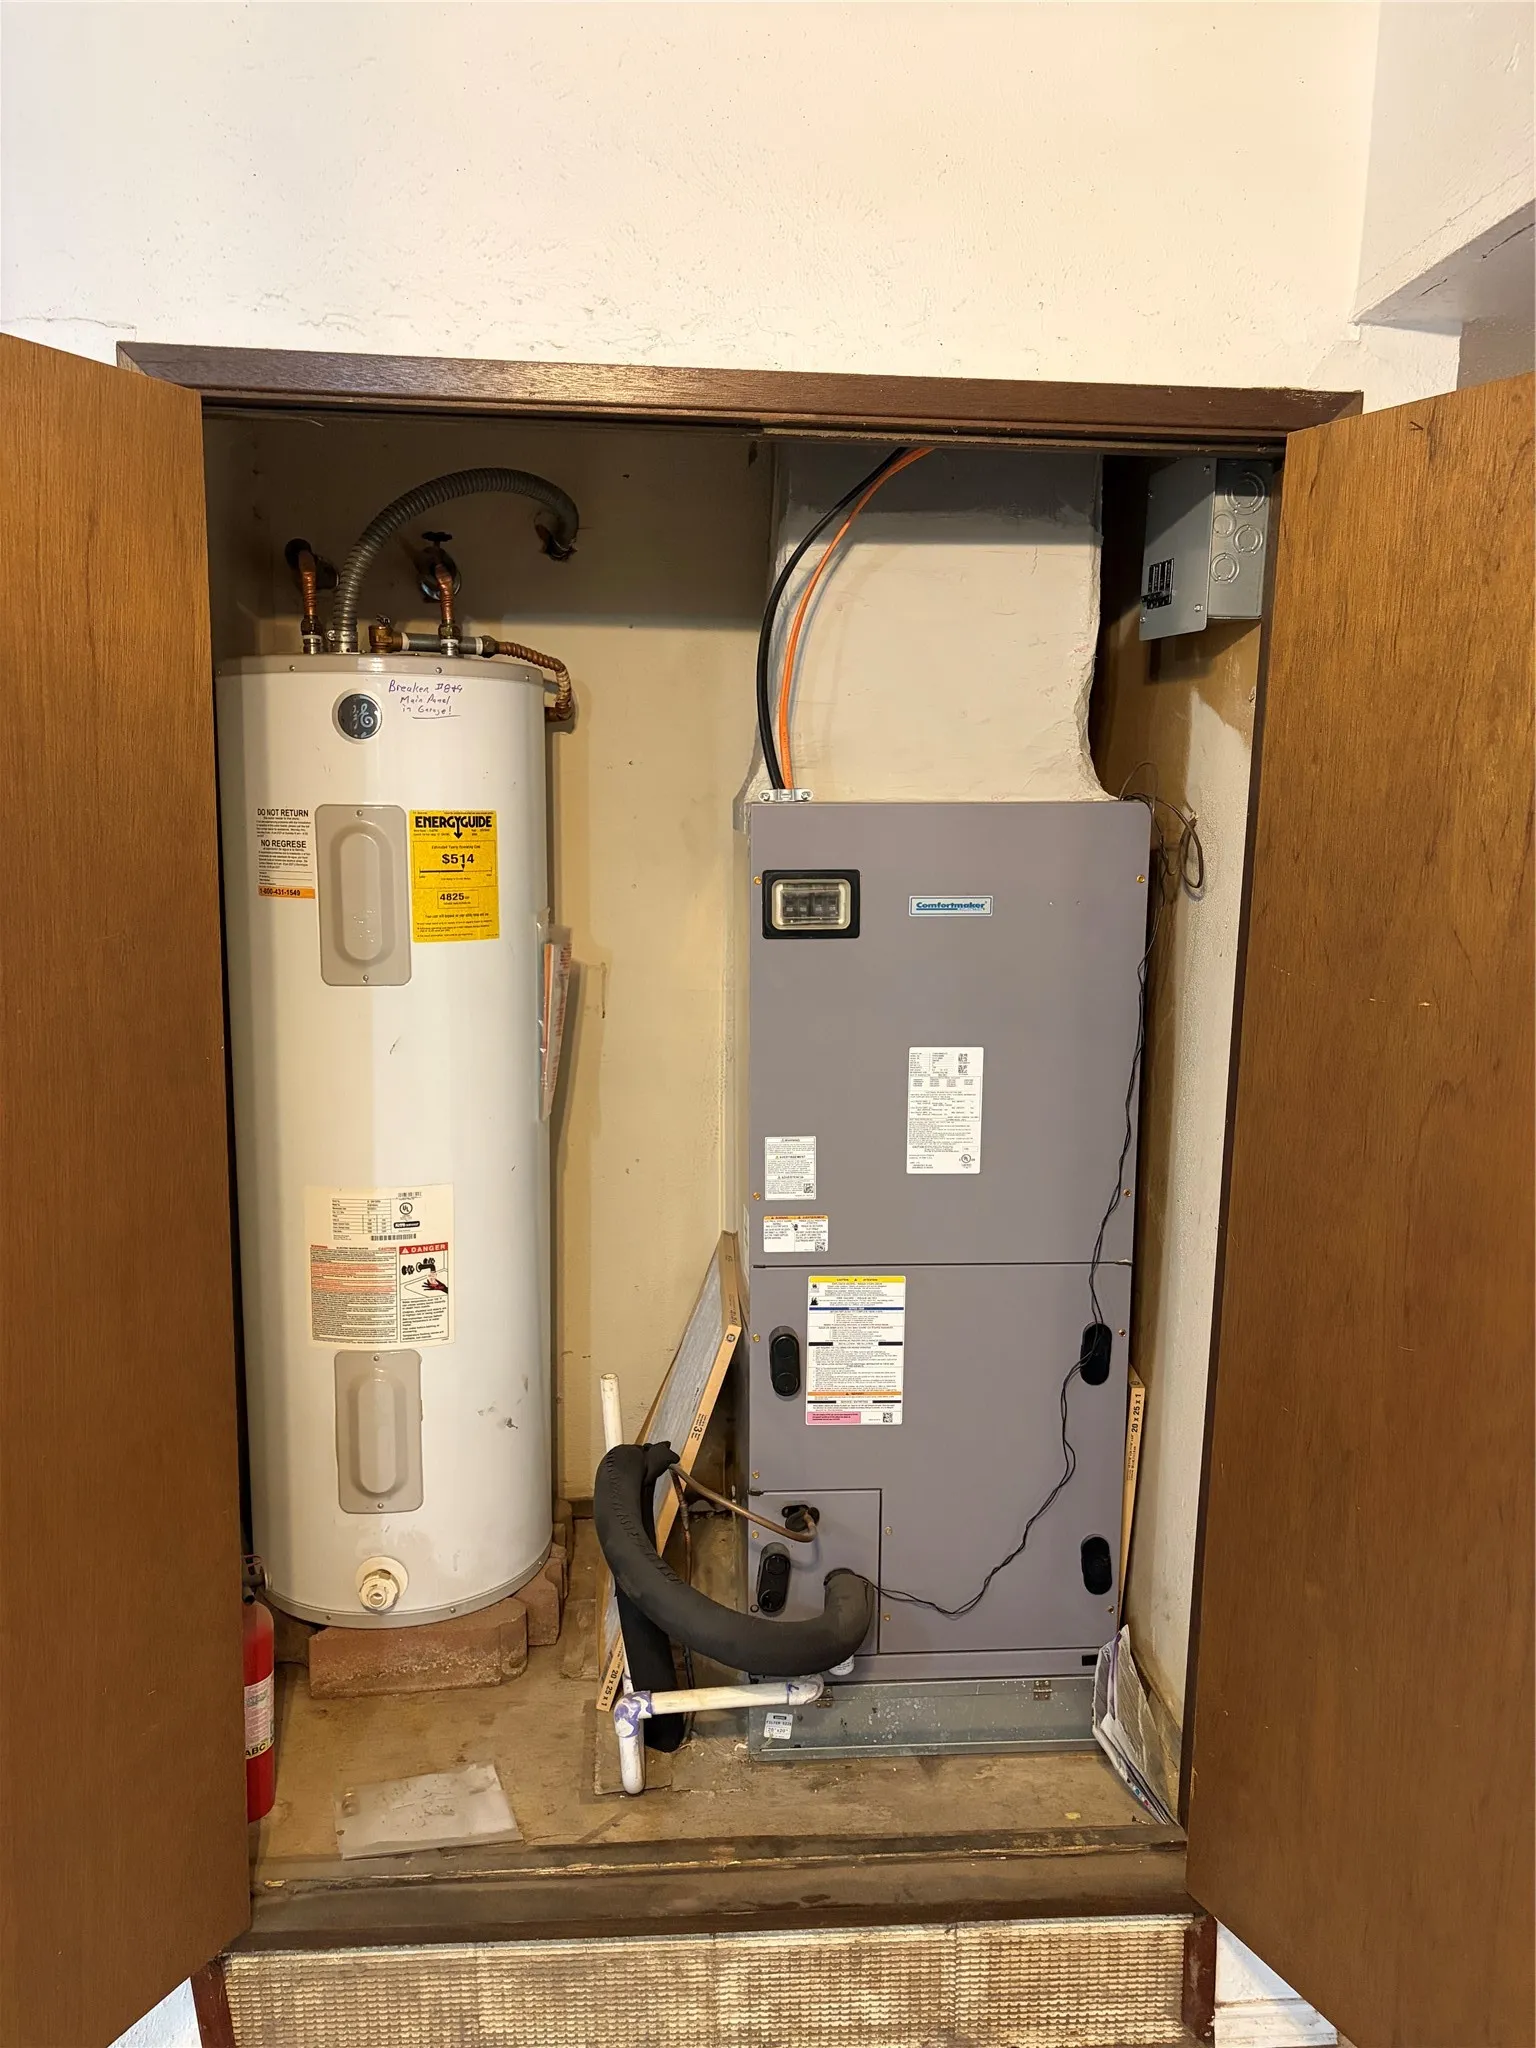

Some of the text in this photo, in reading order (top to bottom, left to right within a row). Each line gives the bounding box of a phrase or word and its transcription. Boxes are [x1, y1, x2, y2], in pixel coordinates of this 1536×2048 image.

[399, 693, 451, 705] Main Panel
[402, 703, 412, 713] in
[257, 808, 309, 817] DO NOT RETURN
[260, 839, 307, 849] NO REGRESE
[441, 853, 475, 865] $514
[439, 892, 465, 901] 4825
[916, 901, 985, 910] Comfortmaker
[410, 1243, 446, 1254] DANGER
[1133, 1406, 1140, 1416] 25
[1131, 1423, 1139, 1433] 20
[610, 1669, 619, 1679] 20
[605, 1685, 613, 1695] 25
[245, 1742, 266, 1757] ABC
